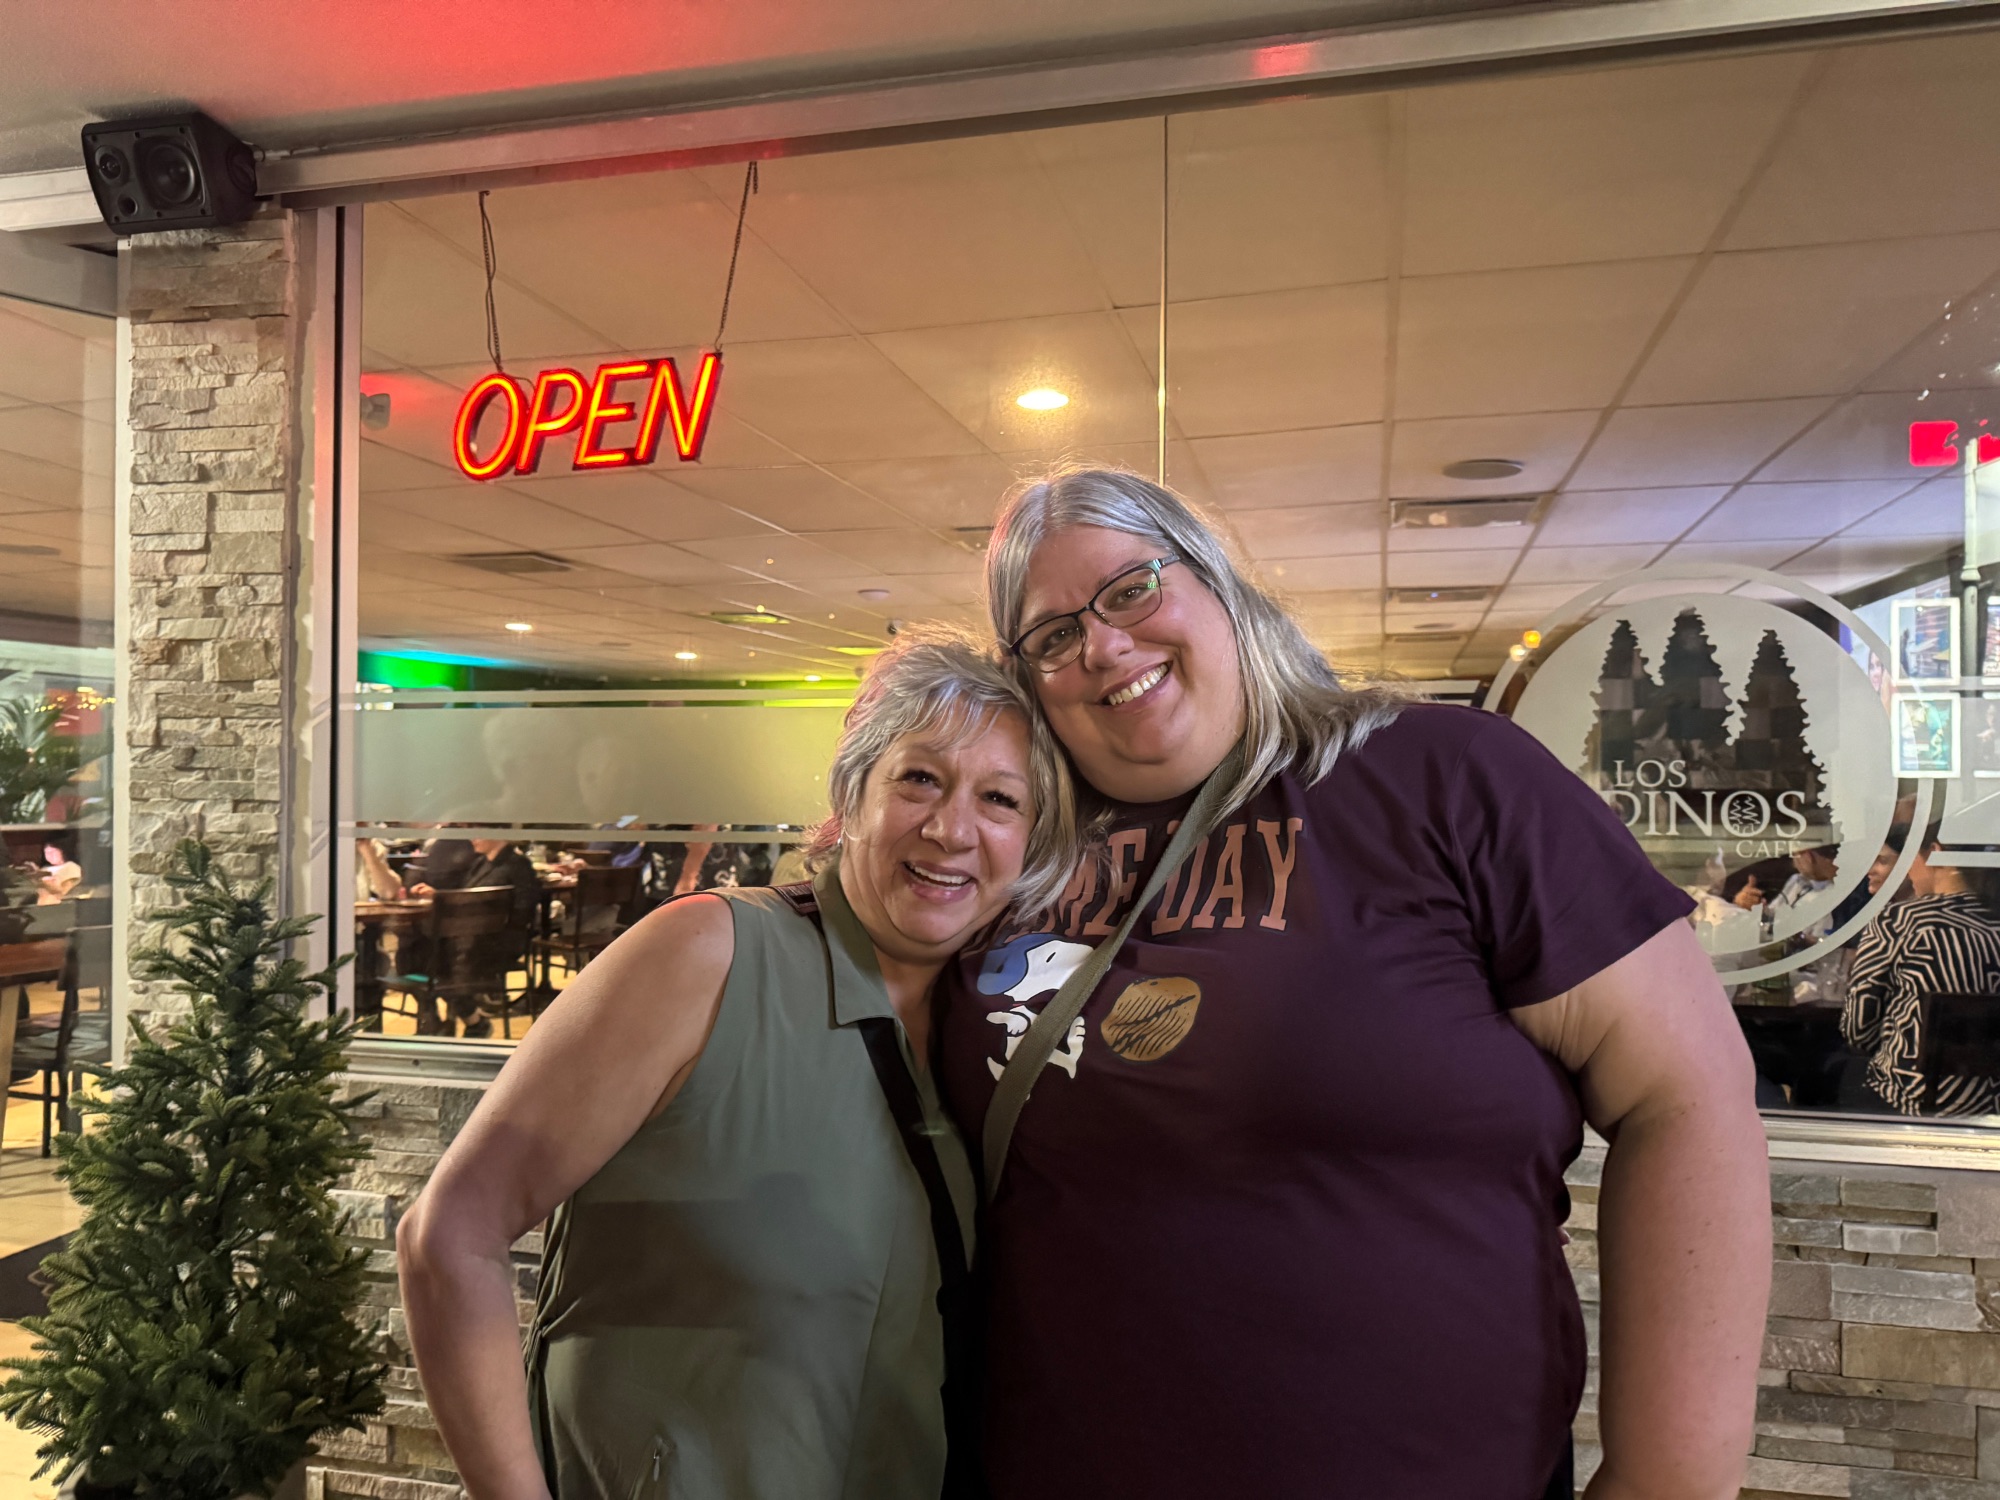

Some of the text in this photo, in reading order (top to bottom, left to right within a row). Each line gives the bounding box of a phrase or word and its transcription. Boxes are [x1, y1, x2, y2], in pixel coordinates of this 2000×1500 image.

[454, 352, 721, 481] OPEN
[1613, 759, 1686, 788] LOS
[1151, 817, 1304, 936] DAY
